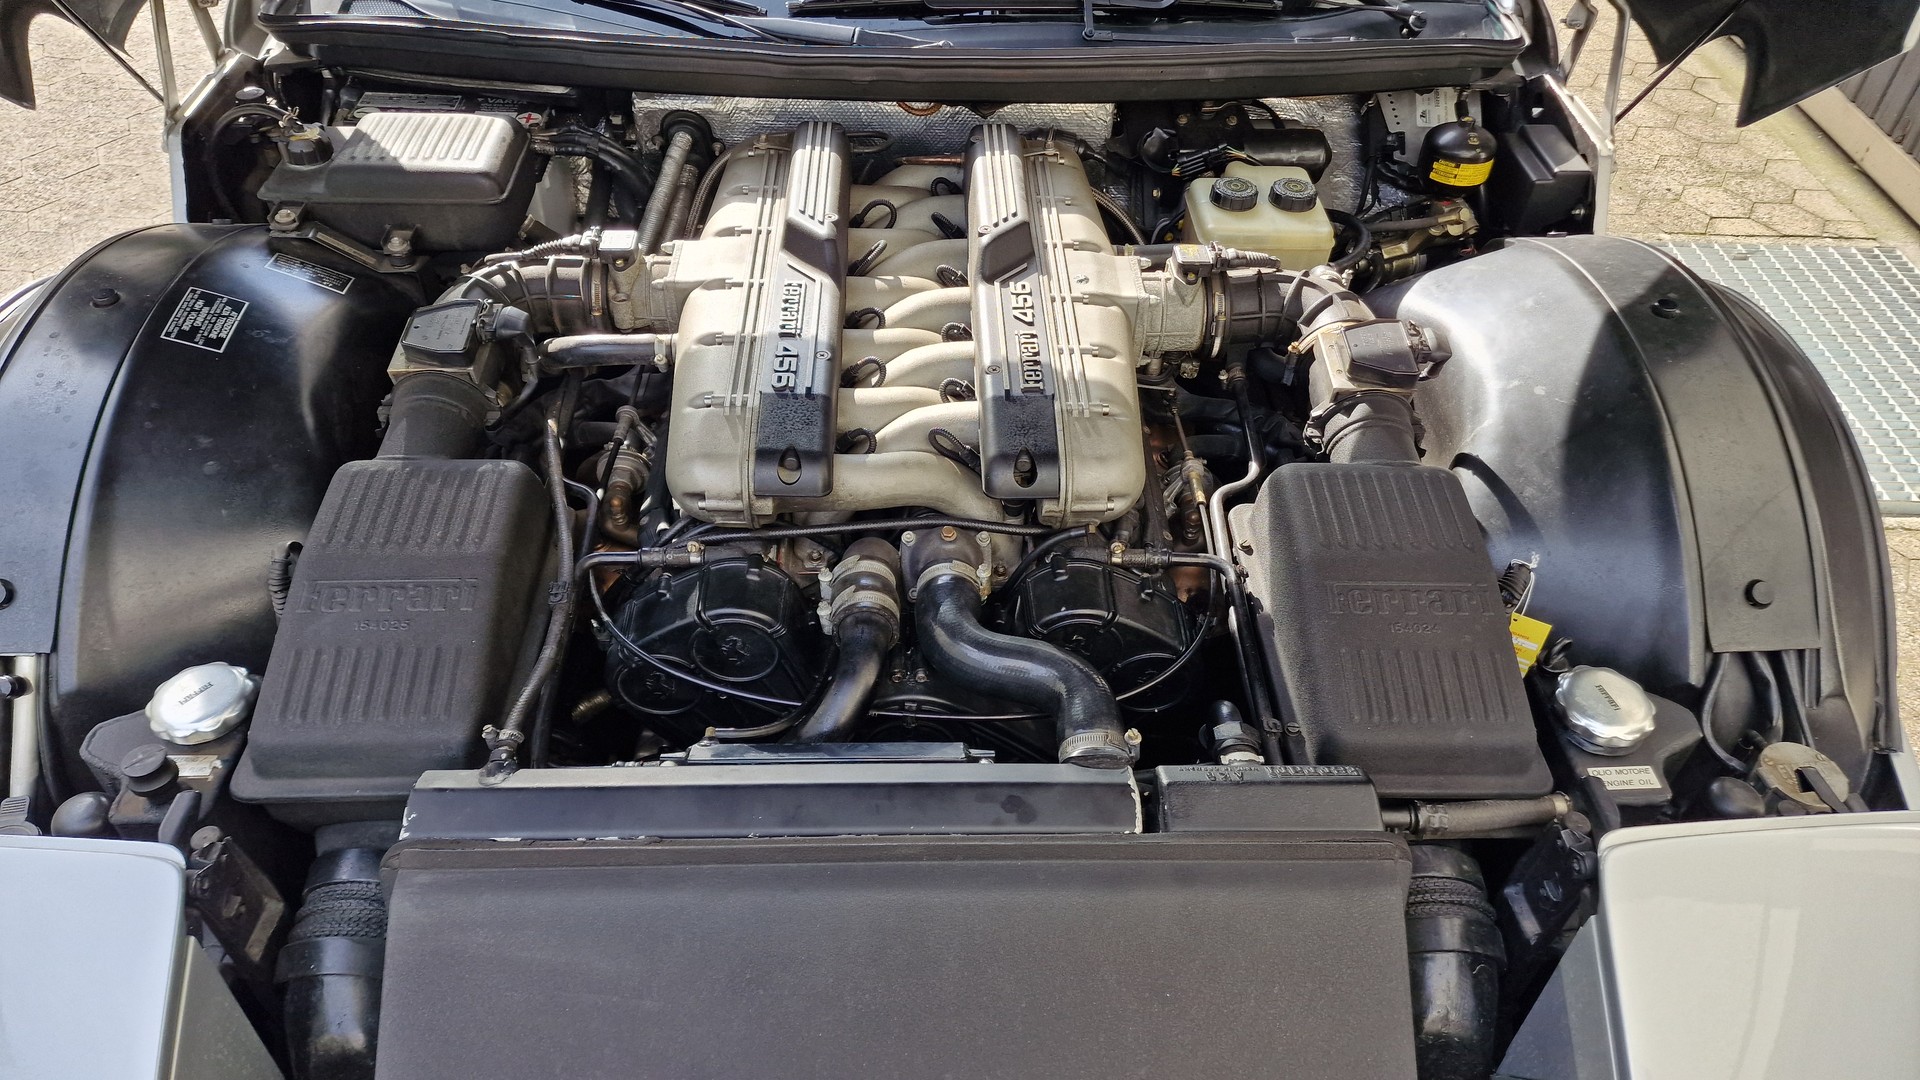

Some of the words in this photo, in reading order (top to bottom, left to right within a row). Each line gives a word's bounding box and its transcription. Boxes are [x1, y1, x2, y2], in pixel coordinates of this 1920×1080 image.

[778, 279, 807, 339] Ferrari
[1009, 281, 1035, 326] 456
[771, 341, 799, 393] 456
[1015, 330, 1045, 394] Ferrari
[295, 577, 478, 613] Ferrari
[1326, 582, 1495, 616] Ferrari
[1595, 684, 1622, 711] Ferrari
[1591, 769, 1612, 777] OLIO
[1615, 767, 1651, 776] MOTORE
[1638, 778, 1655, 786] OIL
